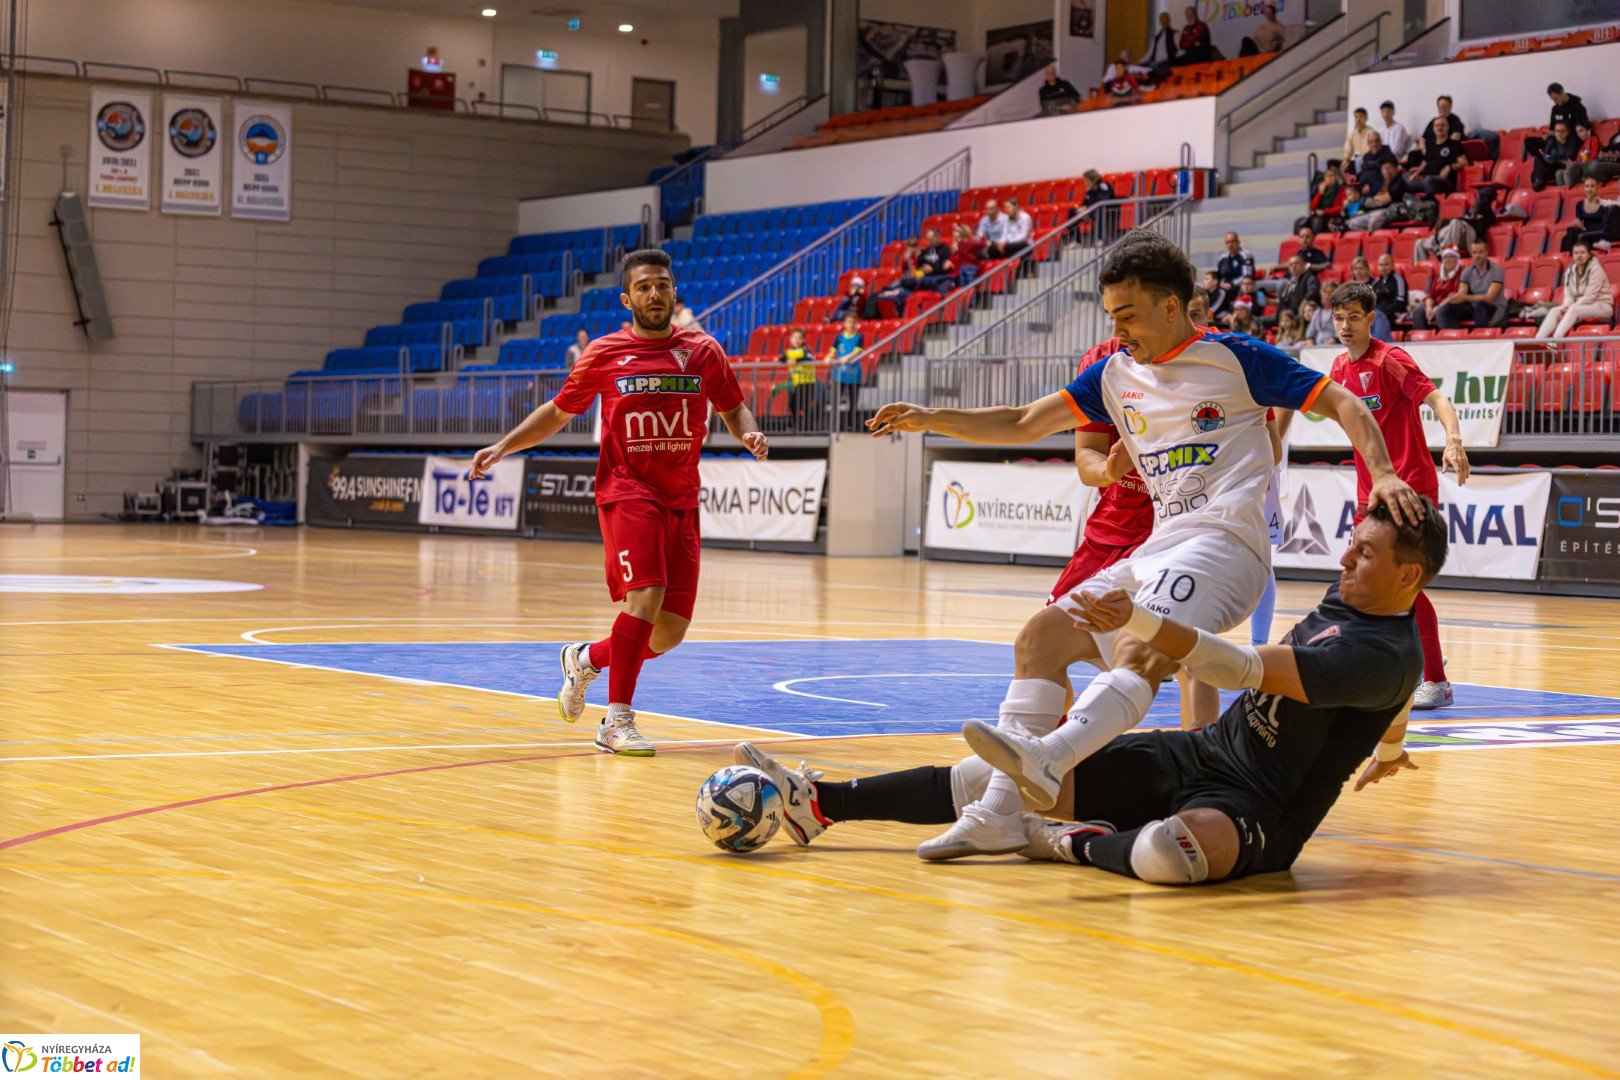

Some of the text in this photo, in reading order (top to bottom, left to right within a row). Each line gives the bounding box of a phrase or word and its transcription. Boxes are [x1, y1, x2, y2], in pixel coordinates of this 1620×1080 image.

[1120, 392, 1144, 400] JAKO
[625, 398, 692, 438] mvl
[627, 443, 652, 452] mezei
[654, 442, 666, 451] vill
[495, 497, 516, 518] KFT
[748, 487, 816, 515] PINCE
[978, 498, 1072, 522] NYÍREGYHÁZA
[1269, 512, 1280, 530] 4
[1335, 500, 1538, 546] ANAL
[618, 550, 634, 582] 5
[1152, 568, 1196, 602] 10
